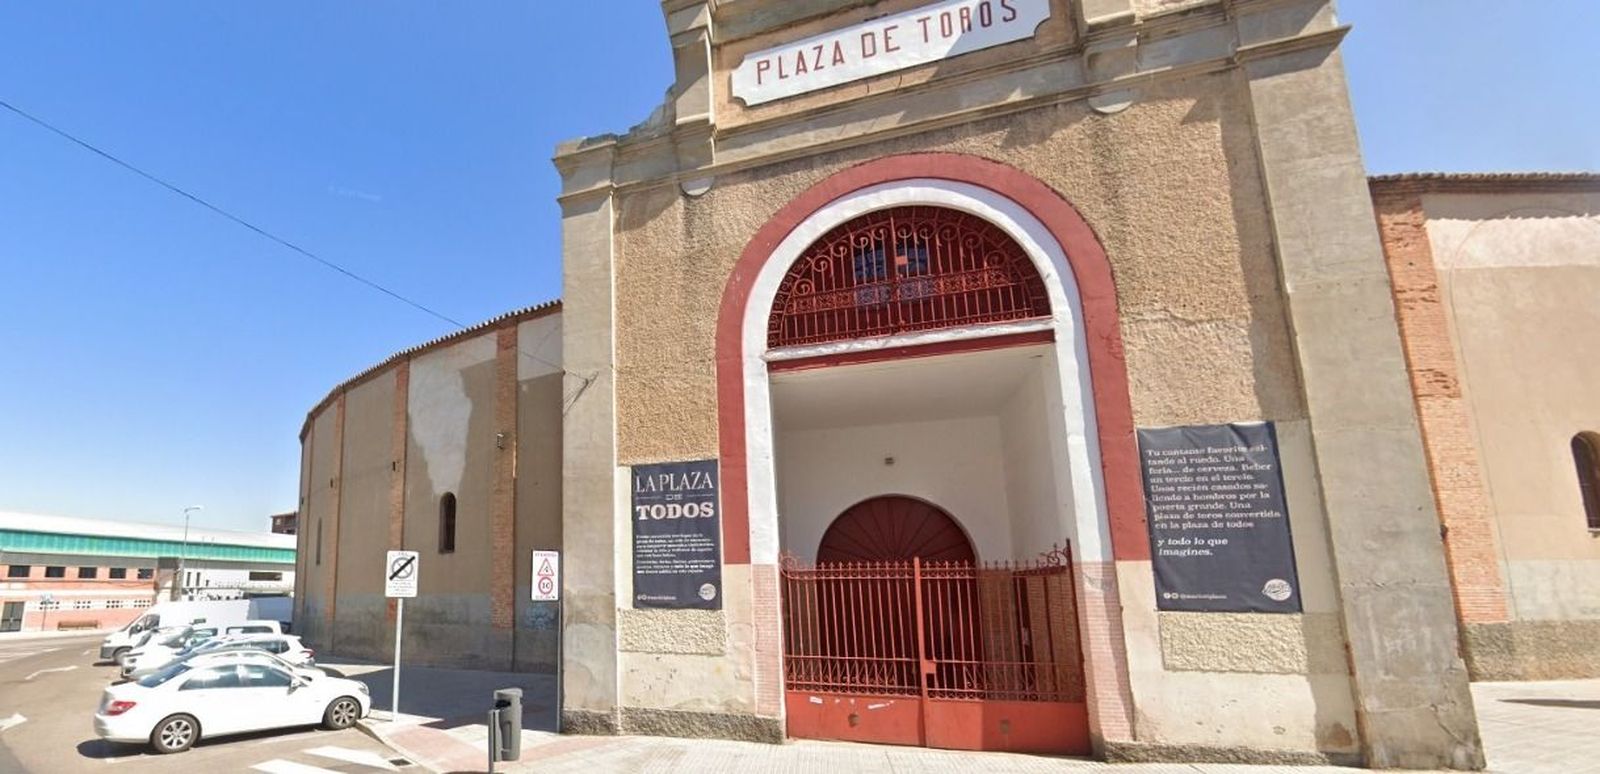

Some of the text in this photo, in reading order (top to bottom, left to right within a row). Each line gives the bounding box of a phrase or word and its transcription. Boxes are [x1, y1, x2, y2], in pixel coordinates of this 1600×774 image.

[756, 0, 1017, 85] PLAZA DE TOROS
[636, 471, 714, 493] LA PLAZA
[1260, 490, 1270, 499] la
[636, 502, 715, 520] TODOS
[1182, 511, 1195, 519] de
[1170, 520, 1180, 529] la
[1182, 520, 1209, 530] plaza
[1211, 520, 1224, 528] de
[1157, 537, 1228, 547] y todo lo que
[1159, 547, 1214, 557] imagines.
